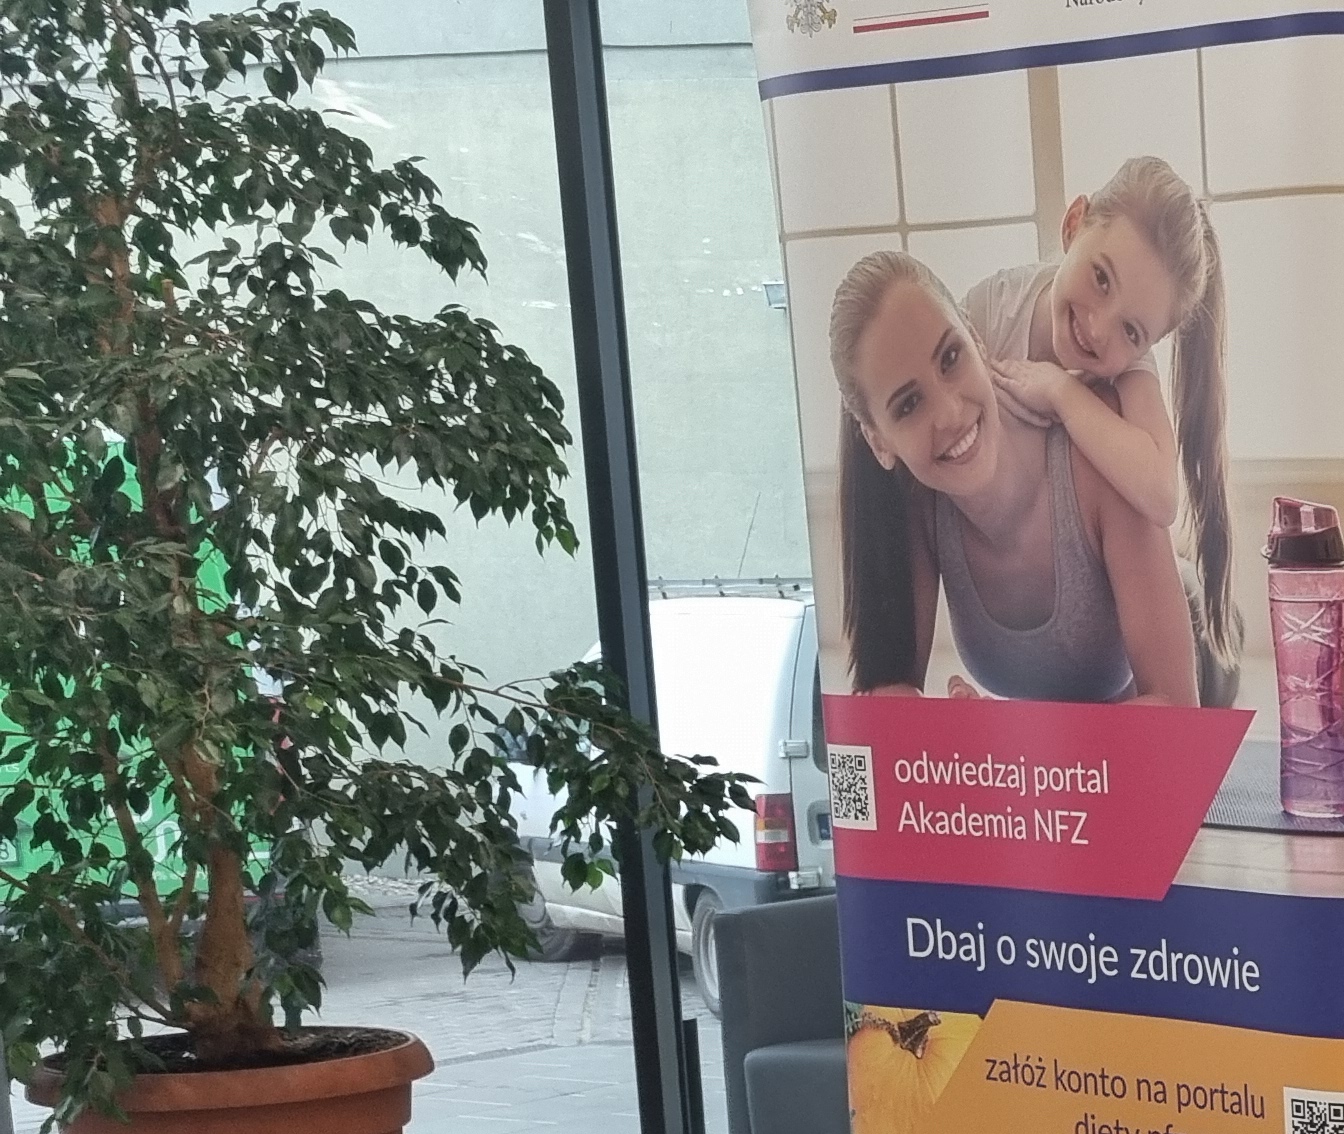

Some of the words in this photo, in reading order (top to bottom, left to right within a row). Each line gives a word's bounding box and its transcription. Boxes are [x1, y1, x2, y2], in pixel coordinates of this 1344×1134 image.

[893, 751, 1027, 796] odwiedzaj
[1033, 759, 1109, 798] portal
[897, 799, 1028, 842] Akademia
[1034, 808, 1089, 846] NFZ
[906, 917, 986, 971] Dbaj
[997, 933, 1016, 966] o
[1025, 933, 1119, 984] swoje
[1130, 939, 1261, 993] zdrowie
[985, 1053, 1047, 1091] załóż
[1054, 1058, 1127, 1100] konto
[1136, 1076, 1169, 1105] na
[1177, 1082, 1266, 1120] portalu
